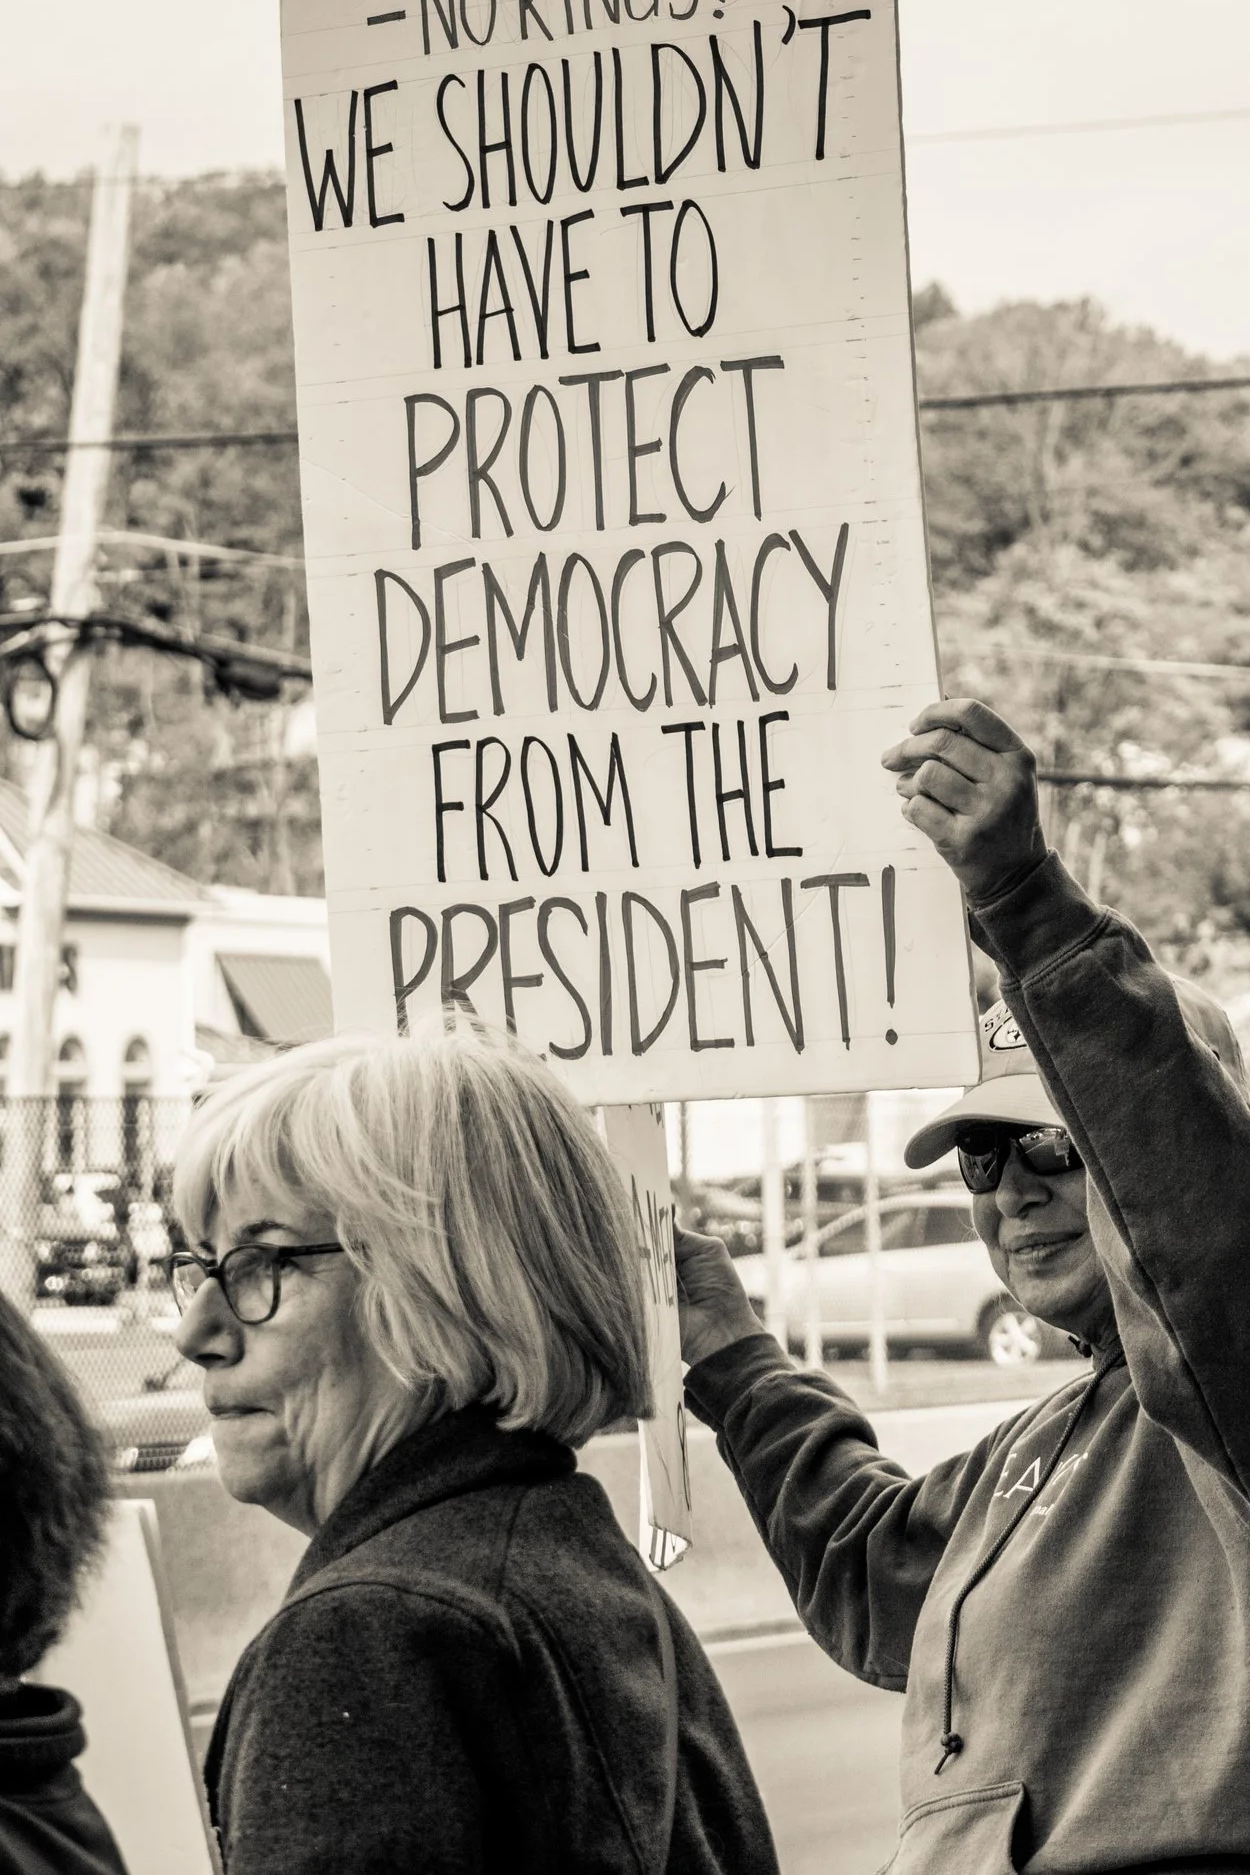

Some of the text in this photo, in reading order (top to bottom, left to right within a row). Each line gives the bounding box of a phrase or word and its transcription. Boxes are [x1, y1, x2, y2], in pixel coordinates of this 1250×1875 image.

[295, 5, 871, 231] WE SHOULDN'T
[427, 198, 719, 368] HAVE TO
[404, 355, 785, 549] PROTECT
[375, 522, 850, 725] DEMOCRACY
[432, 710, 802, 883] FROM THE
